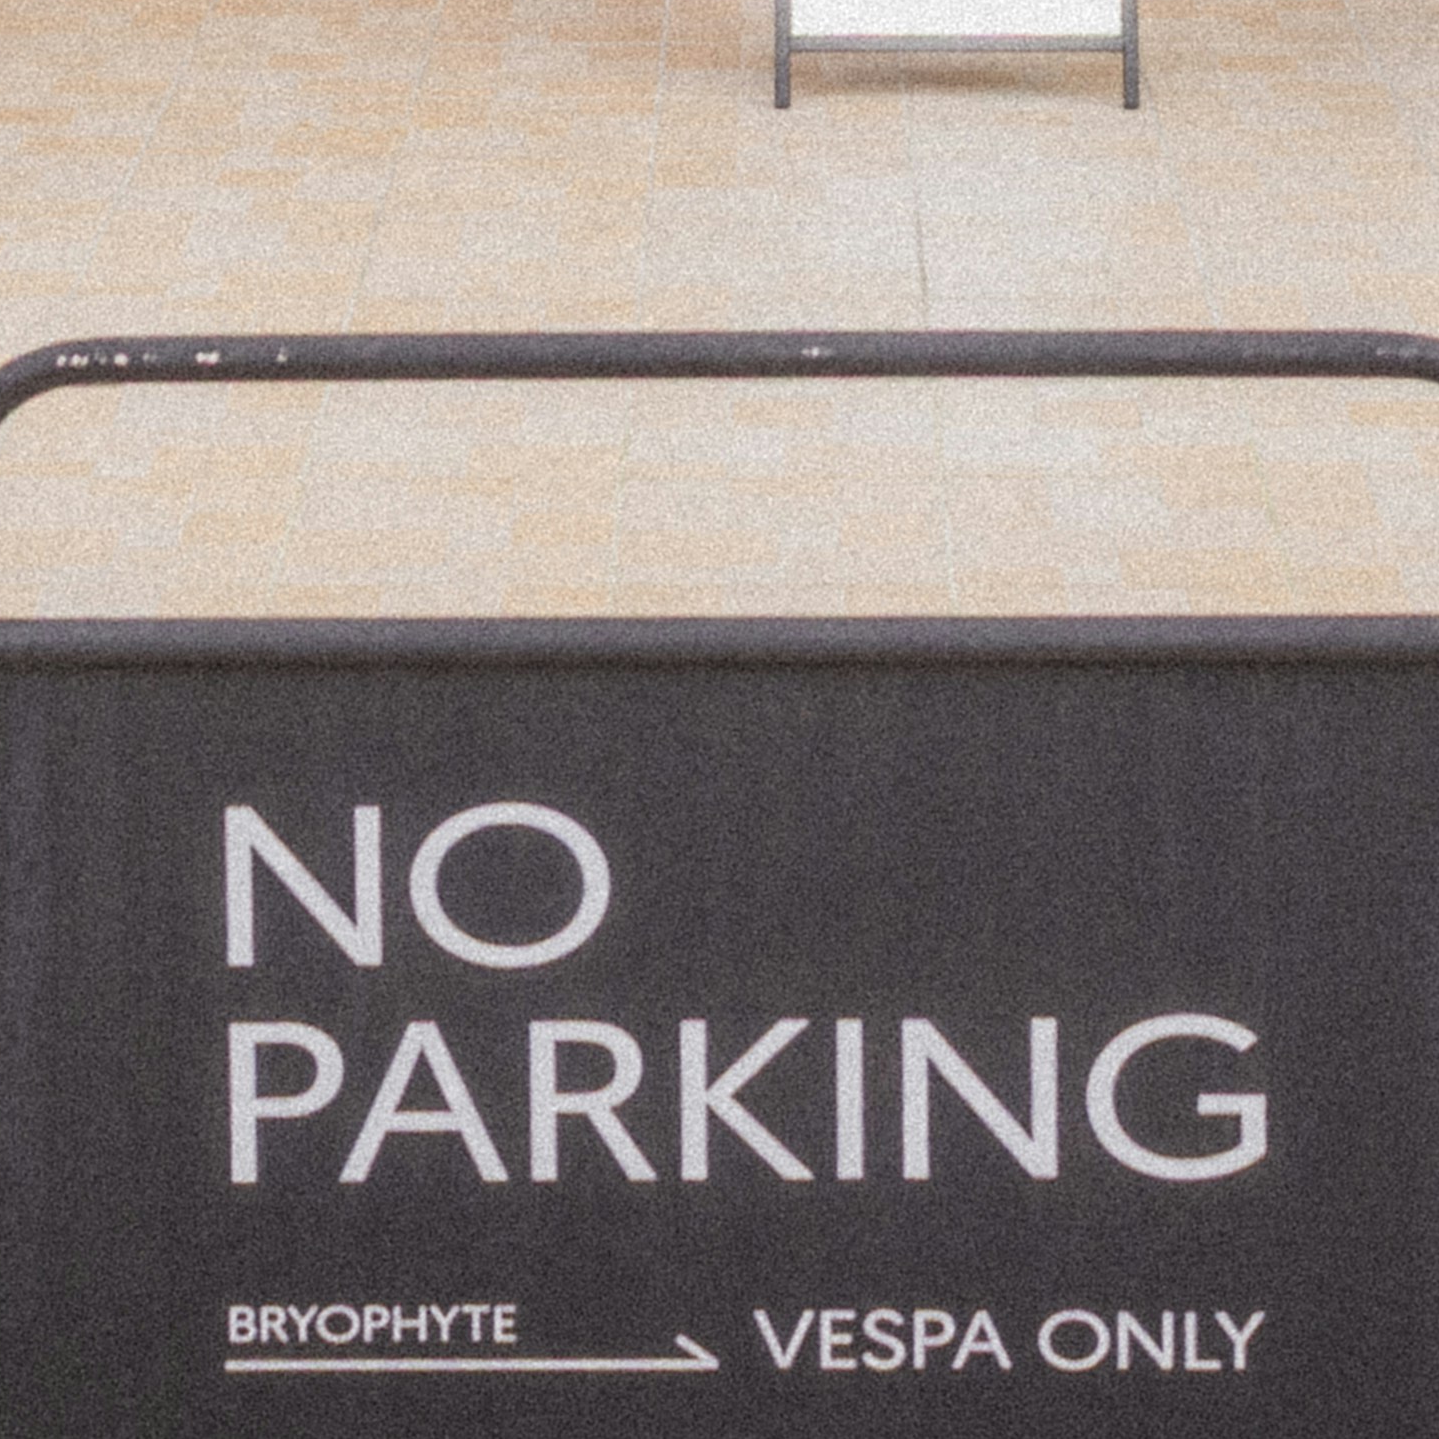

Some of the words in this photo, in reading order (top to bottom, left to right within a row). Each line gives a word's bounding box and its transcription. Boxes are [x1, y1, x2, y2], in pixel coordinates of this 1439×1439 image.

[223, 801, 612, 969] NO
[228, 1012, 1268, 1184] PARKING
[227, 1303, 517, 1344] BRYOPHYTE
[753, 1307, 1011, 1373] VESPA
[1037, 1307, 1265, 1373] ONLY
